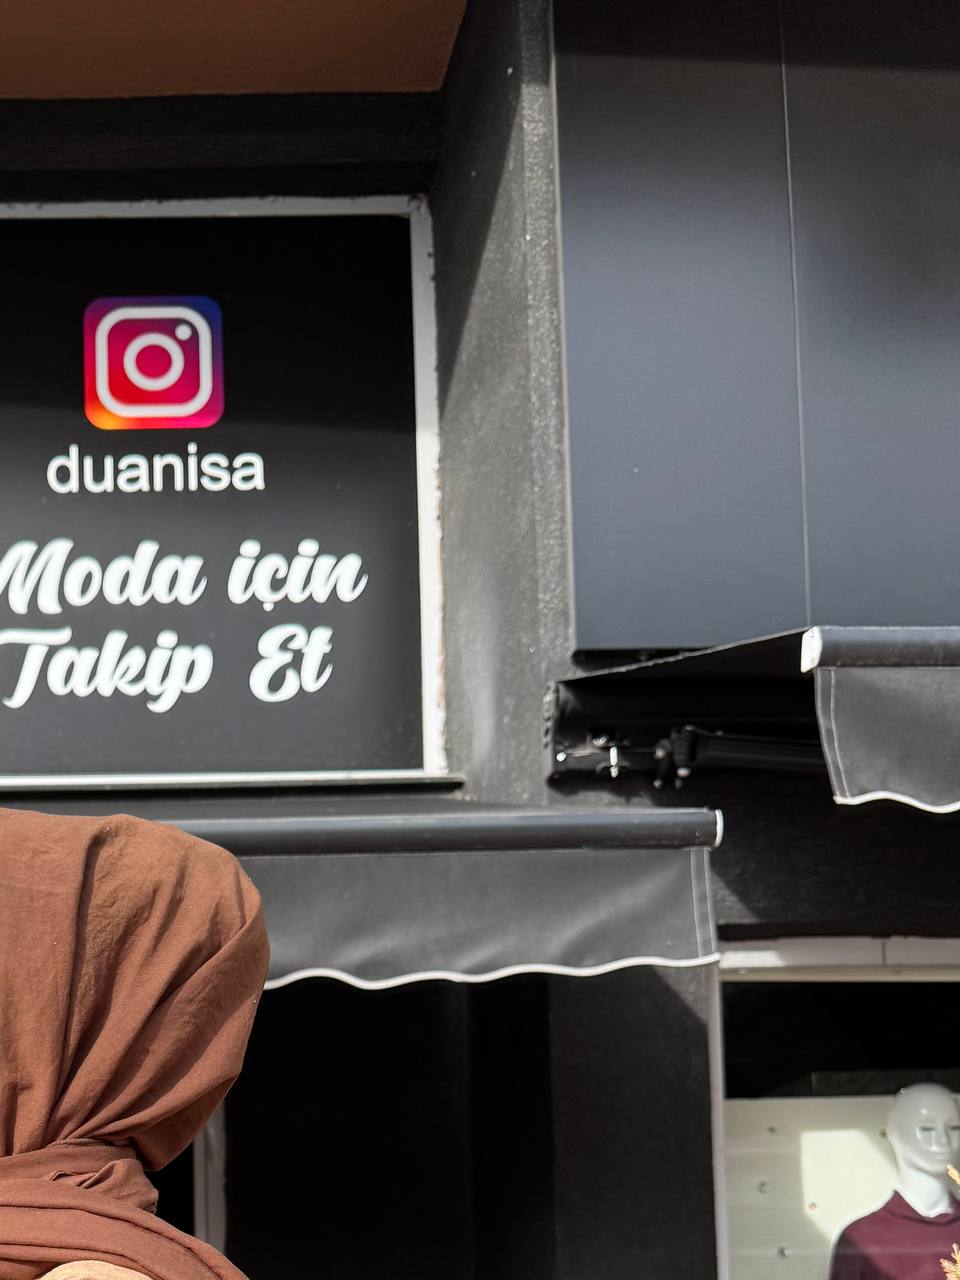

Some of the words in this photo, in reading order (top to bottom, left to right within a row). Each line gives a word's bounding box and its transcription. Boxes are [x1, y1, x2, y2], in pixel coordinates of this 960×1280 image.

[46, 441, 266, 494] duanisa
[226, 538, 369, 612] için
[249, 624, 334, 702] Et
